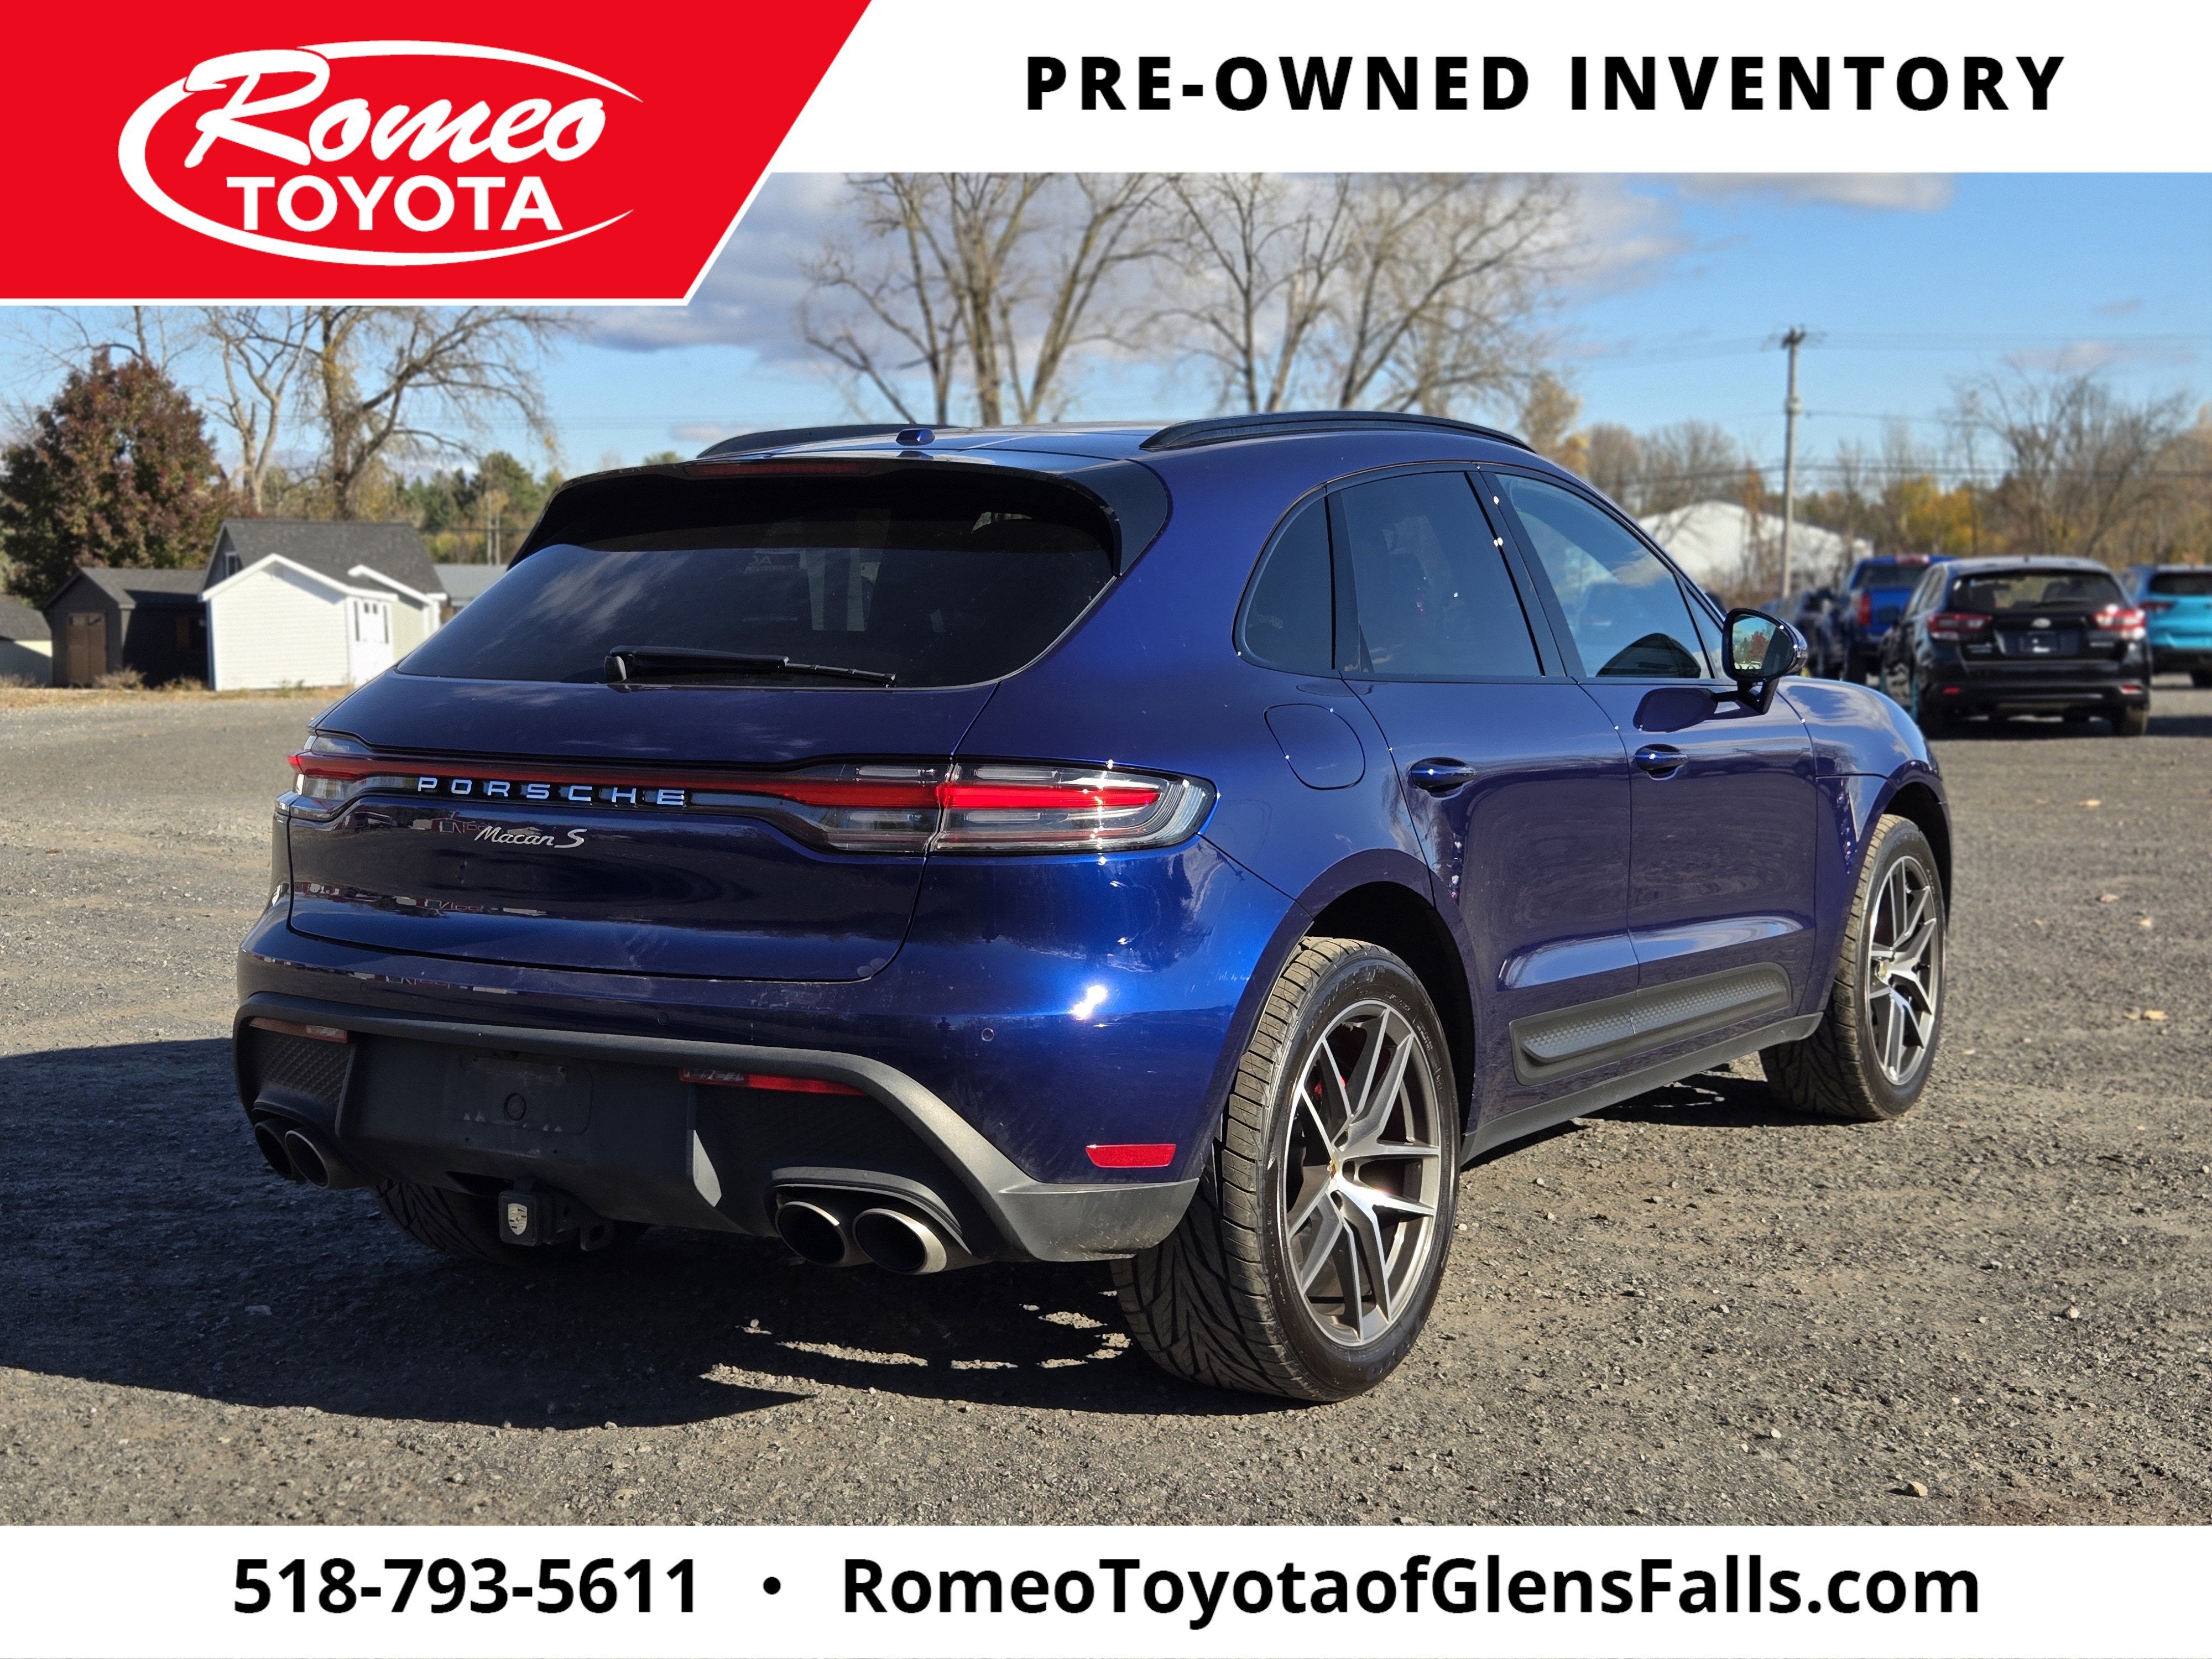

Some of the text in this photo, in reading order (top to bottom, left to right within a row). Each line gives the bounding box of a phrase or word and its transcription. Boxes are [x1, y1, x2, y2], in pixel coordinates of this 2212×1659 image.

[418, 776, 685, 806] PORSCHE
[474, 826, 588, 848] Macan S
